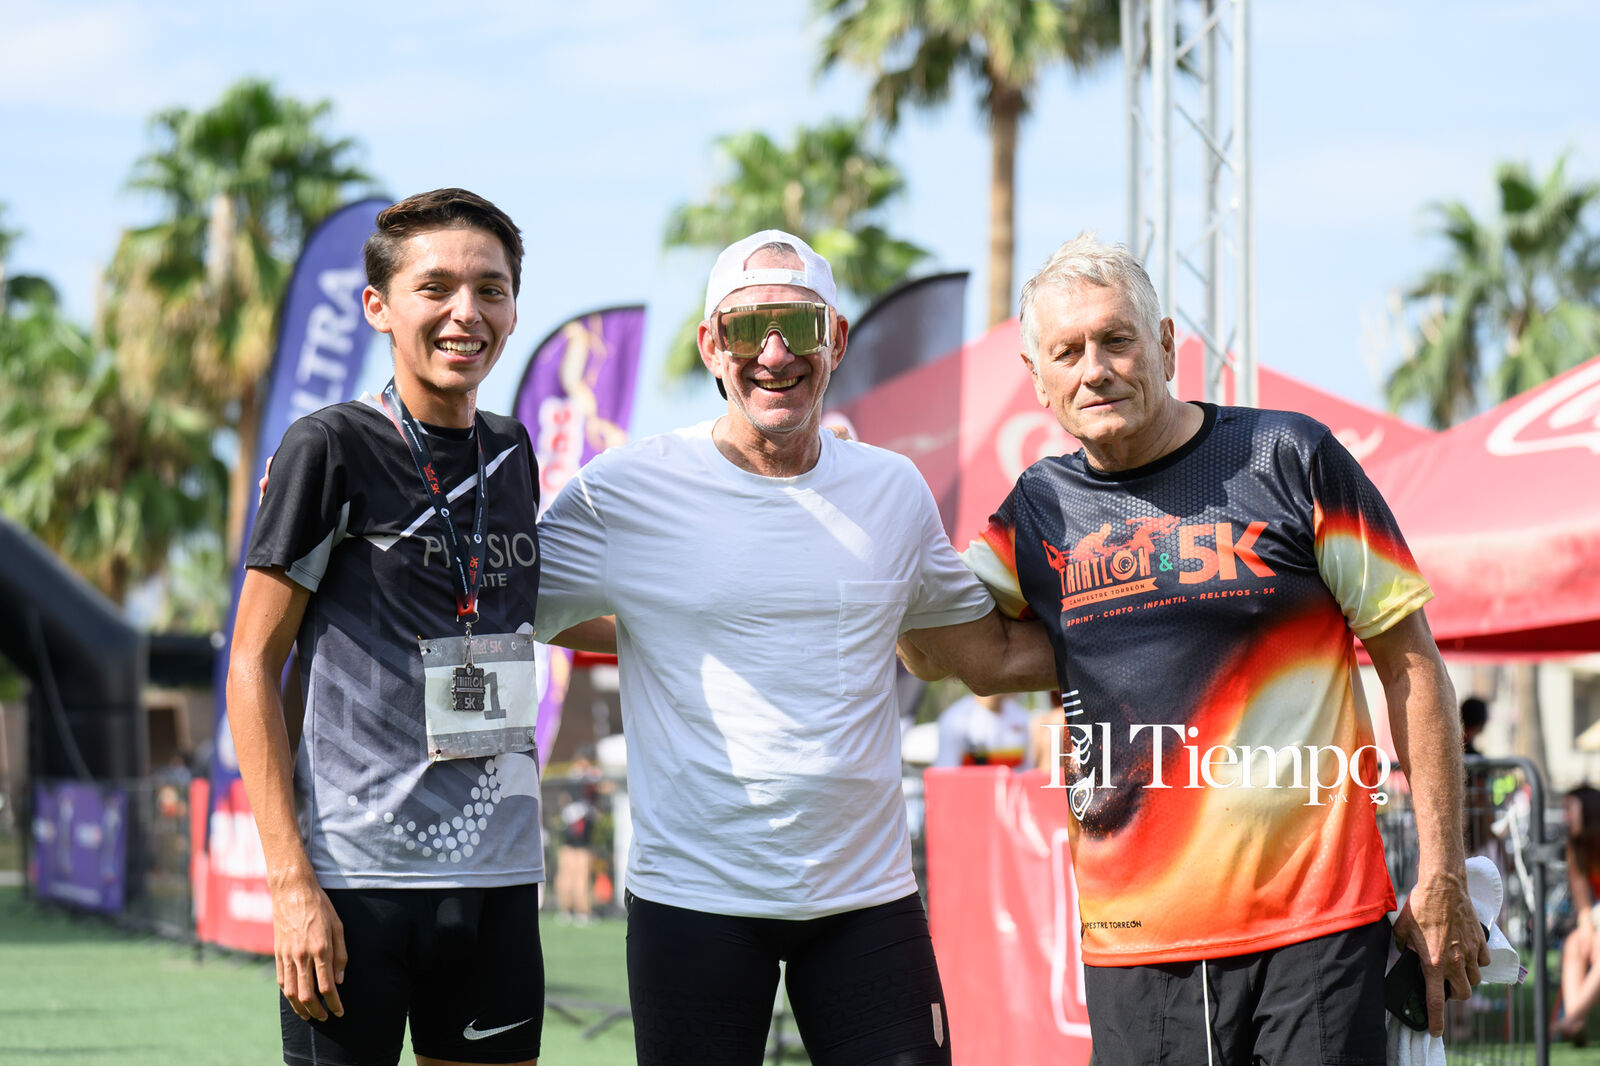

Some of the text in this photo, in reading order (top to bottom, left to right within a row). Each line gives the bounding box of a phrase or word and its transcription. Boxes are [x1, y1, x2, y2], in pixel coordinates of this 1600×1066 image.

[288, 267, 366, 421] LTRA
[423, 532, 537, 568] PSIO
[1059, 521, 1277, 596] TRIATLON & 5K
[1066, 613, 1095, 628] SPRINT
[1103, 605, 1134, 618] CORTO
[1143, 595, 1188, 611] INFANTIL
[1199, 588, 1251, 600] RELEVOS
[1263, 587, 1277, 596] 5K
[1068, 591, 1109, 606] CAMPESTRE
